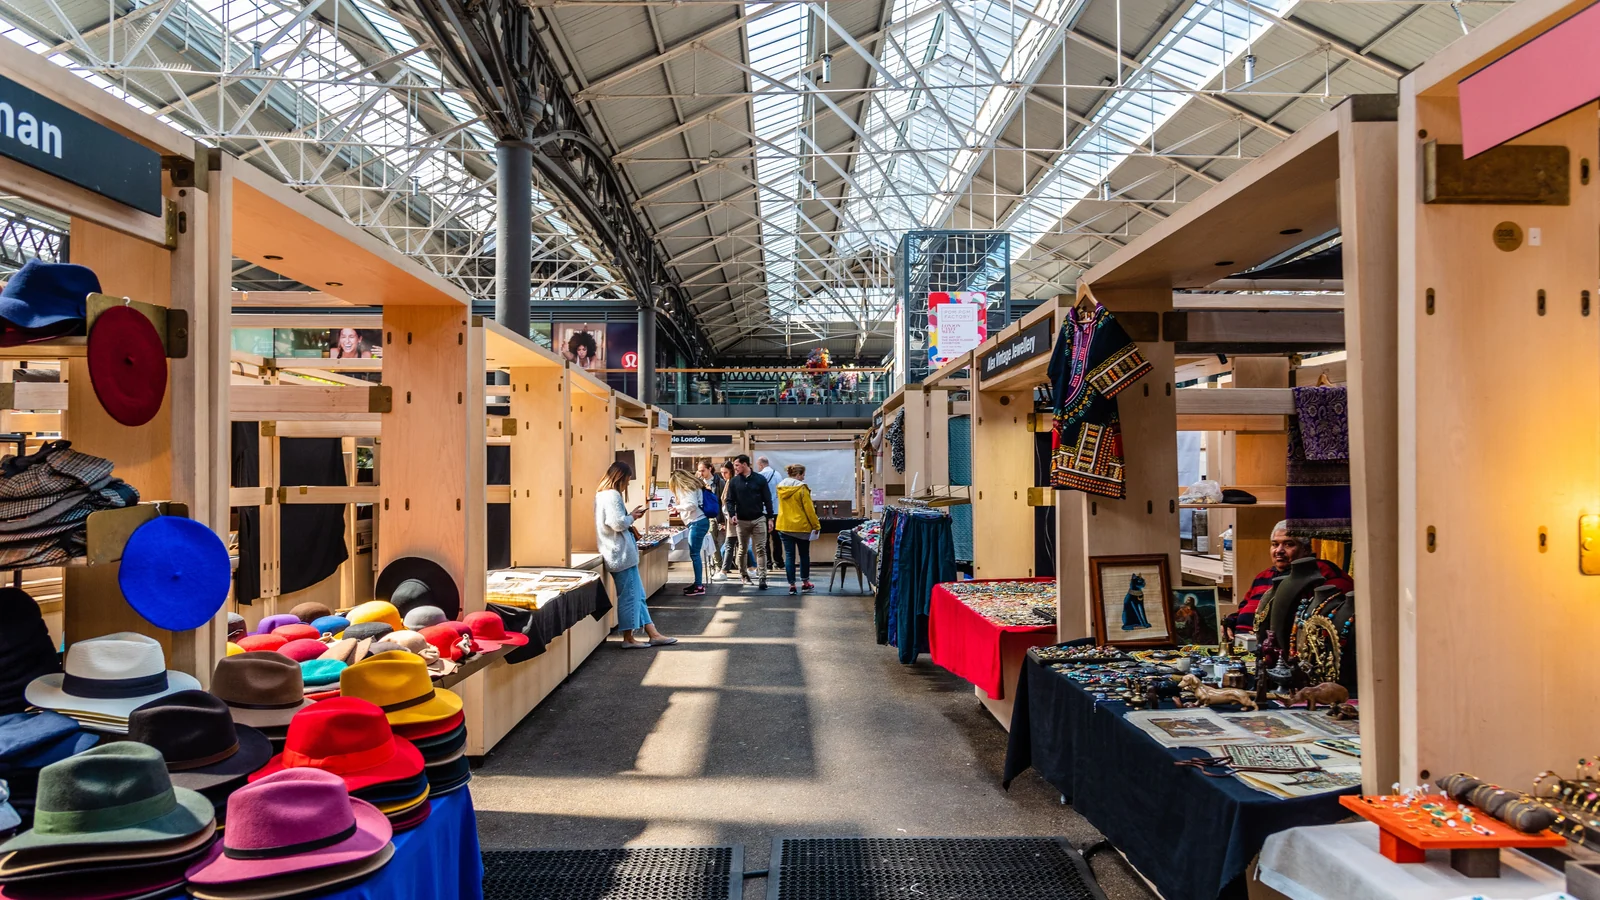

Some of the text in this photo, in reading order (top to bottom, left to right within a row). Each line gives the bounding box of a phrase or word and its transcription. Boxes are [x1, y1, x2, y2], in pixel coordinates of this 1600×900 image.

[987, 335, 1036, 372] Alex Vintage Jewellery
